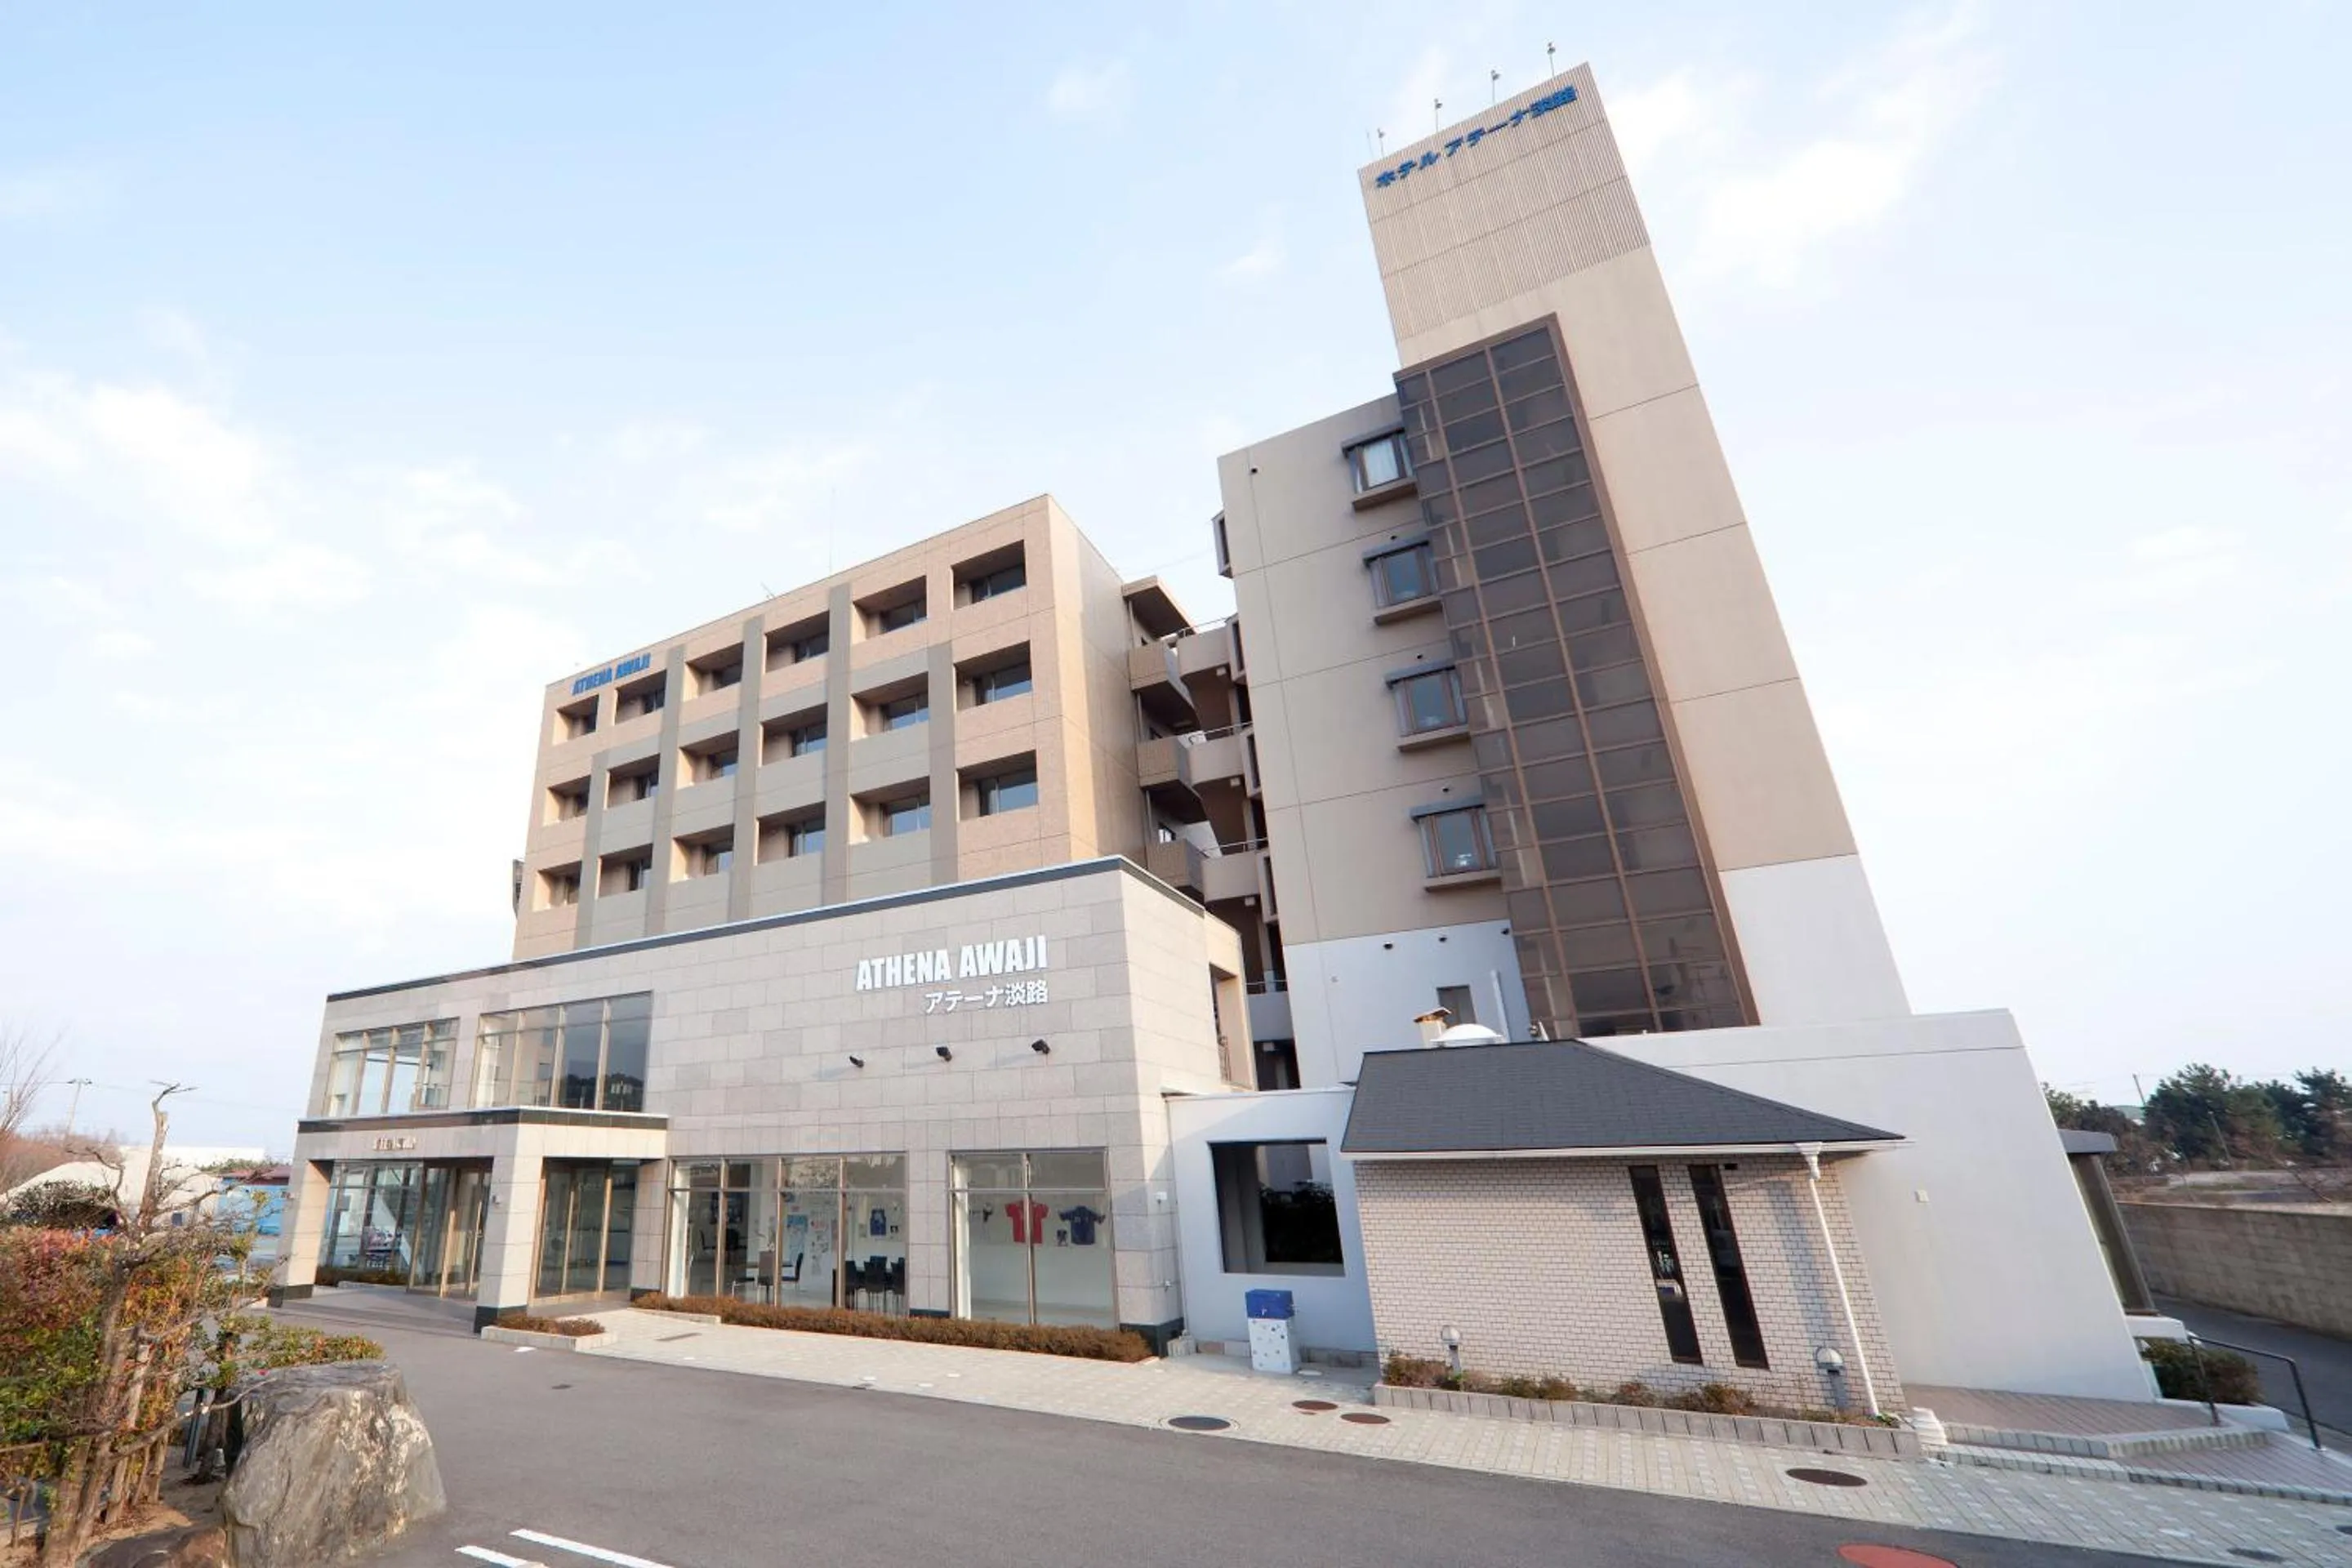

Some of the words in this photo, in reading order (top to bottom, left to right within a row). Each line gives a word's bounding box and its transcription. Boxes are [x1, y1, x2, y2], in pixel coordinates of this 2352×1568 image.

[856, 949, 952, 991] ATHENA
[959, 935, 1048, 978] AWAJI
[924, 979, 1049, 1014] アテーナ淡路
